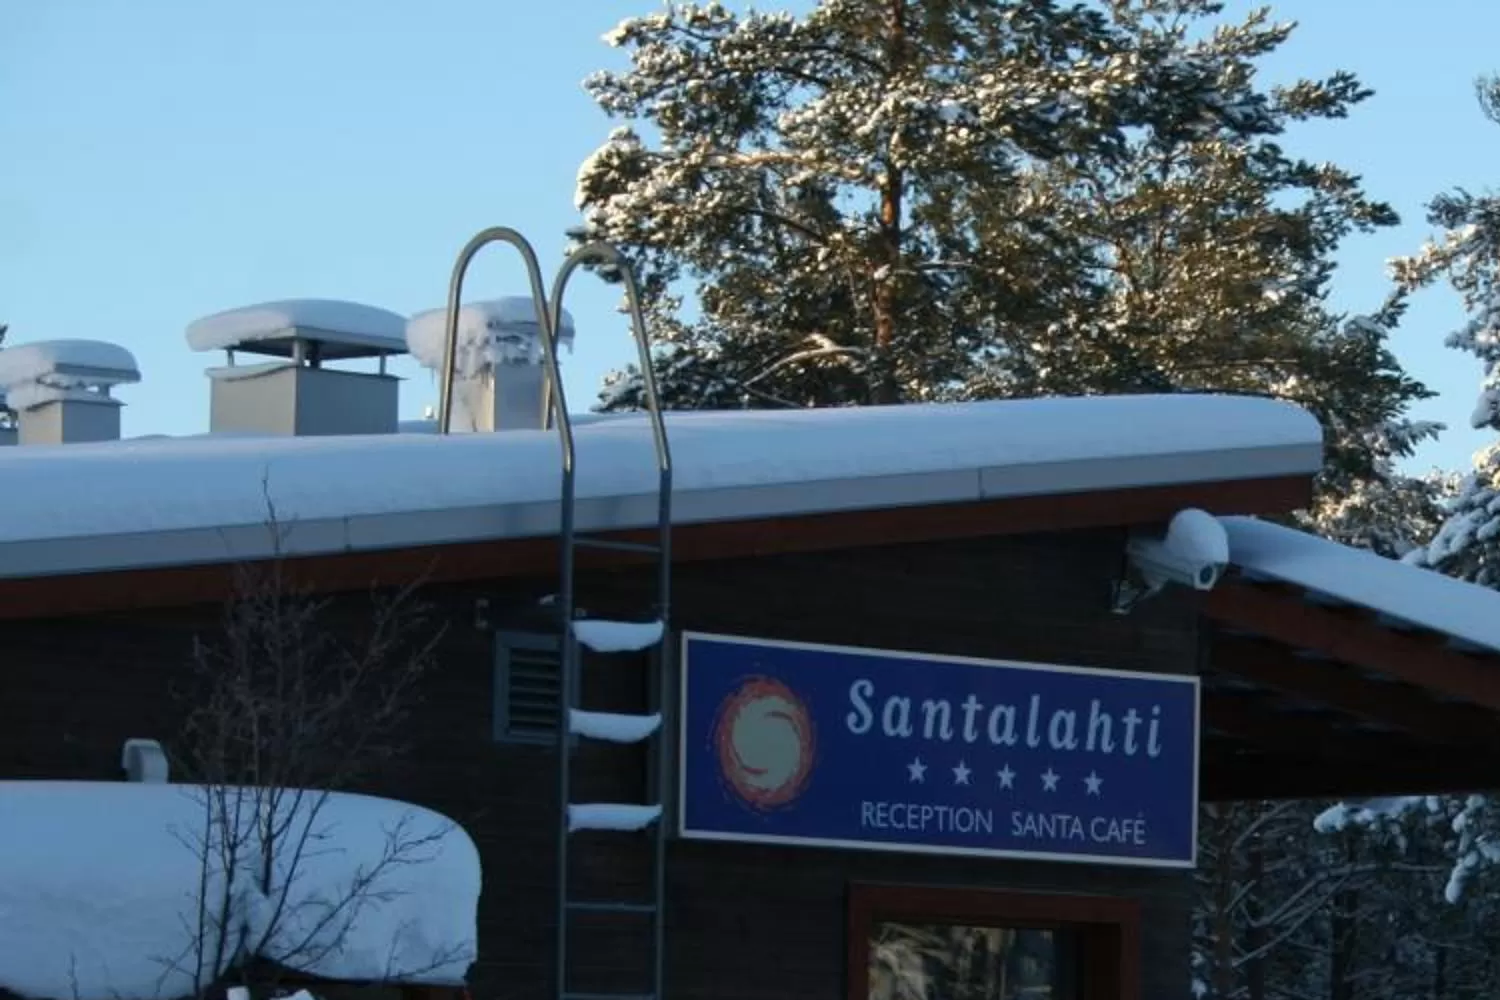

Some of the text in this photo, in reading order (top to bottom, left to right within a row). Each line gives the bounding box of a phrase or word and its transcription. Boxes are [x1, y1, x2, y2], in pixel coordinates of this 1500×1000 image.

[846, 678, 1163, 758] Santalahti
[860, 801, 1147, 846] RECEPTION SANTA CAFÉ
